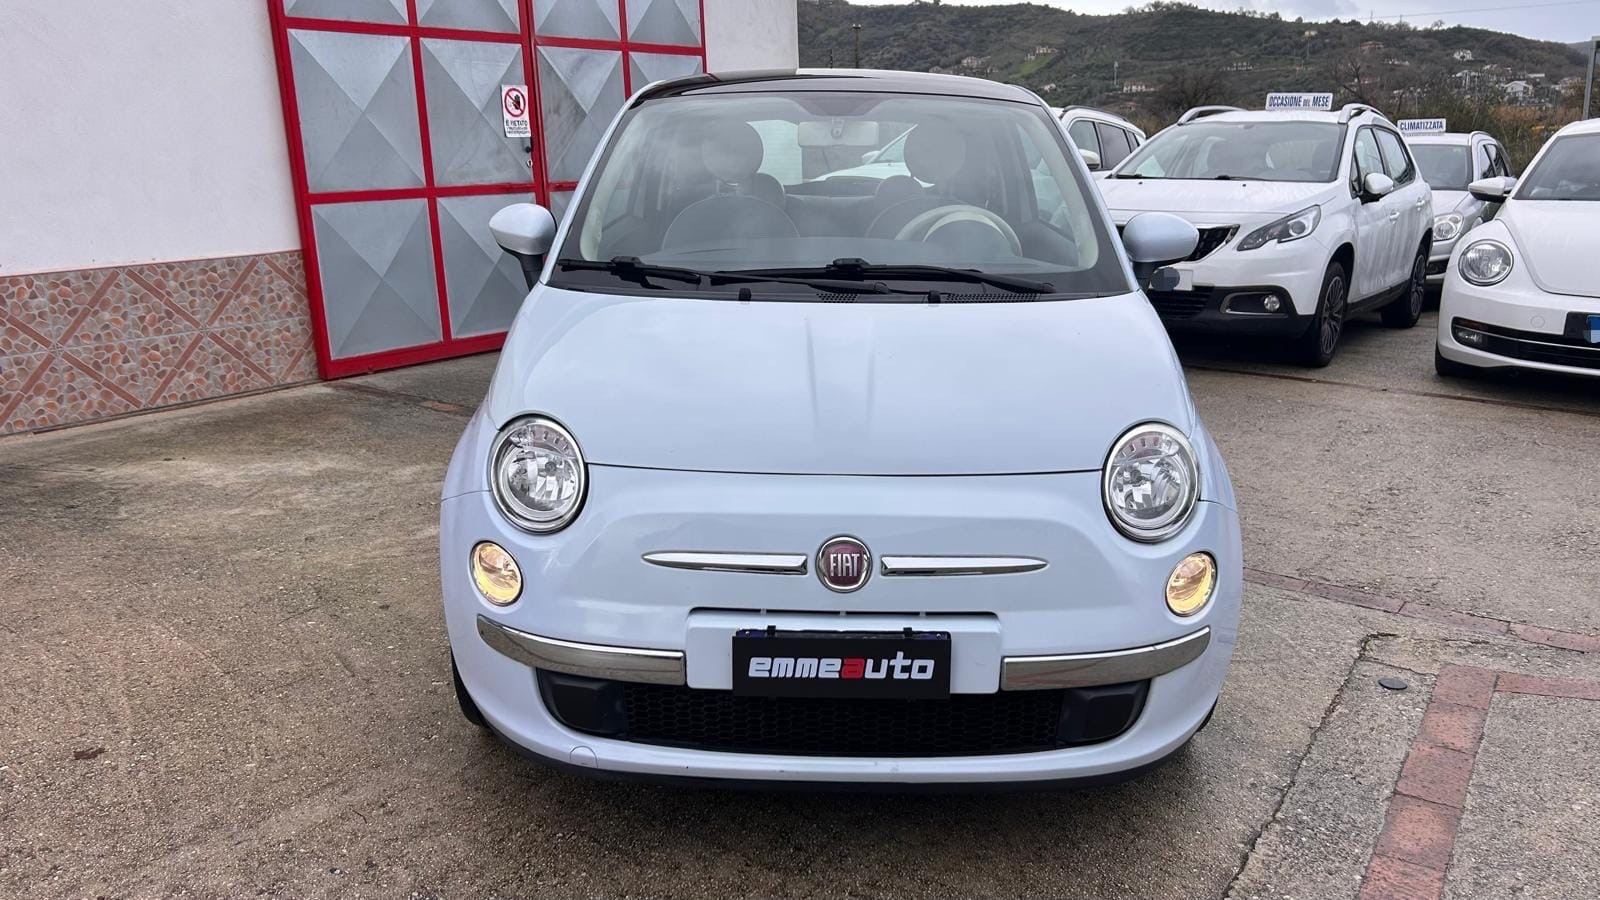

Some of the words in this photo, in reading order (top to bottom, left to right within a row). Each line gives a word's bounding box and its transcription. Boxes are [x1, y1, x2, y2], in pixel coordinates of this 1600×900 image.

[1269, 96, 1302, 107] OCCASIONE
[1312, 96, 1329, 107] MESE
[1400, 121, 1443, 130] CLIMATIZZATA
[830, 553, 860, 577] FIAT
[748, 651, 935, 679] emmeauto
